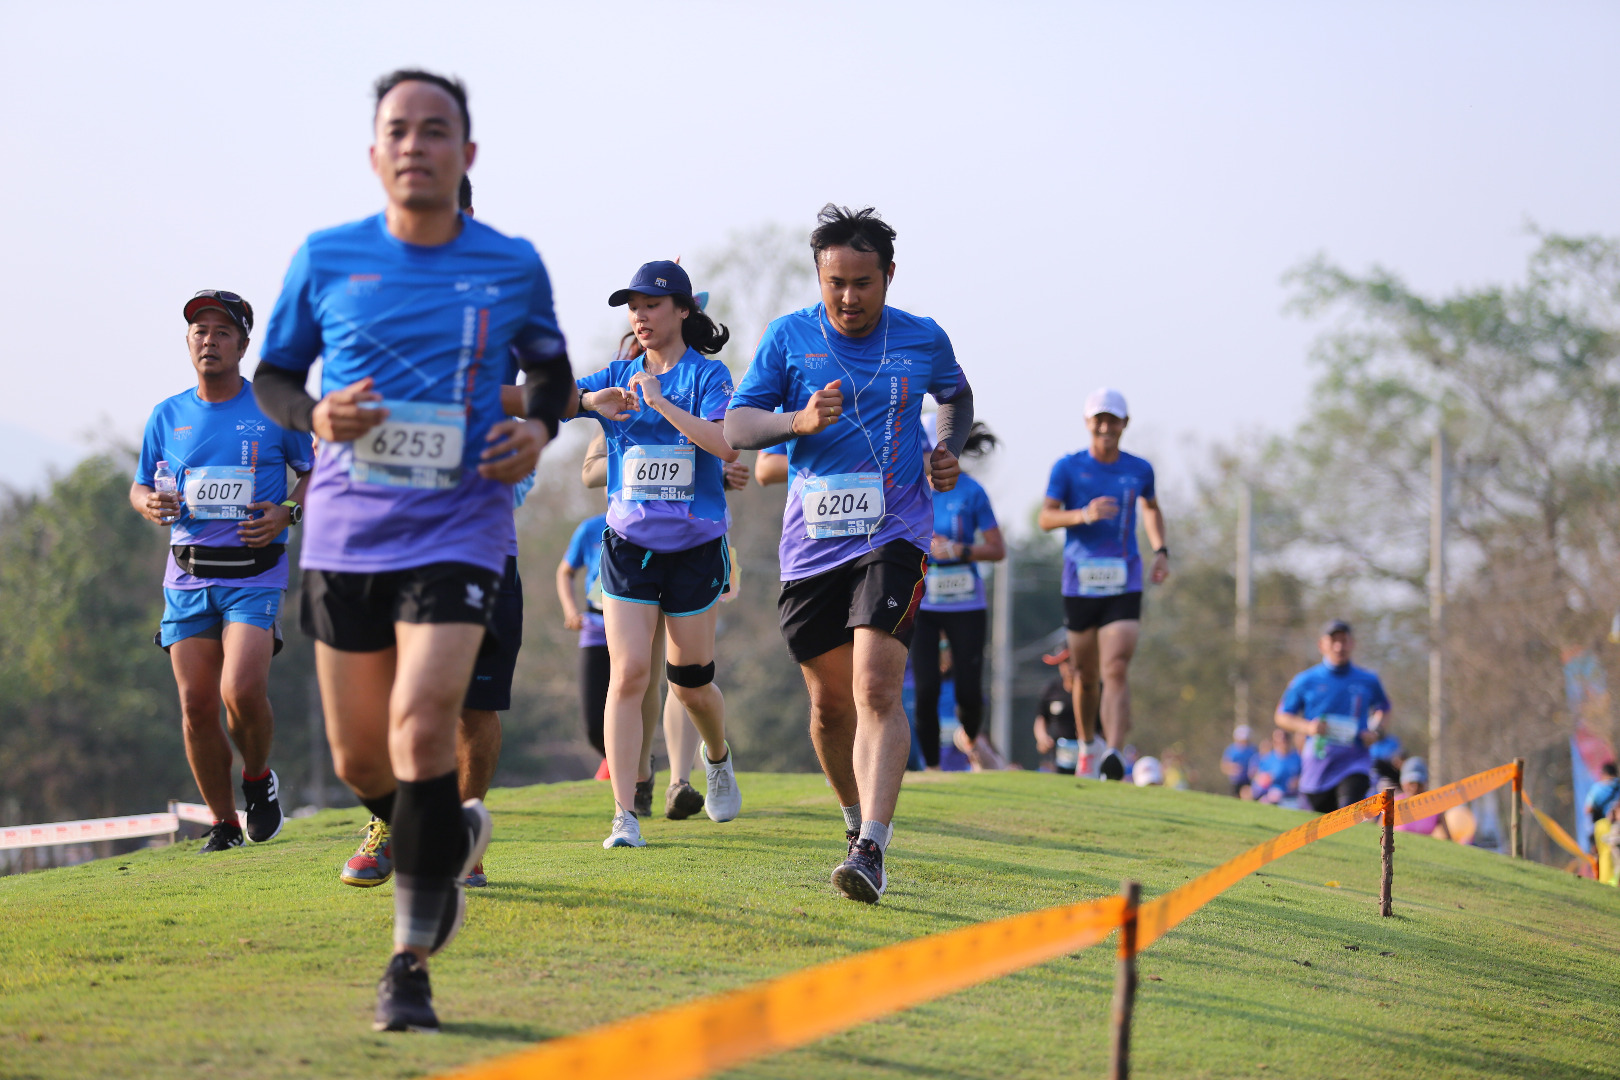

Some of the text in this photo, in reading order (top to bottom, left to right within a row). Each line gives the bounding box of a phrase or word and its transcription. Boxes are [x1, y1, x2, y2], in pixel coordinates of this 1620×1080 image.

[251, 441, 259, 467] SINGH
[372, 429, 446, 459] 6253
[637, 462, 680, 480] 6019
[196, 483, 243, 500] 6007
[677, 490, 686, 499] 16
[817, 492, 869, 516] 6204
